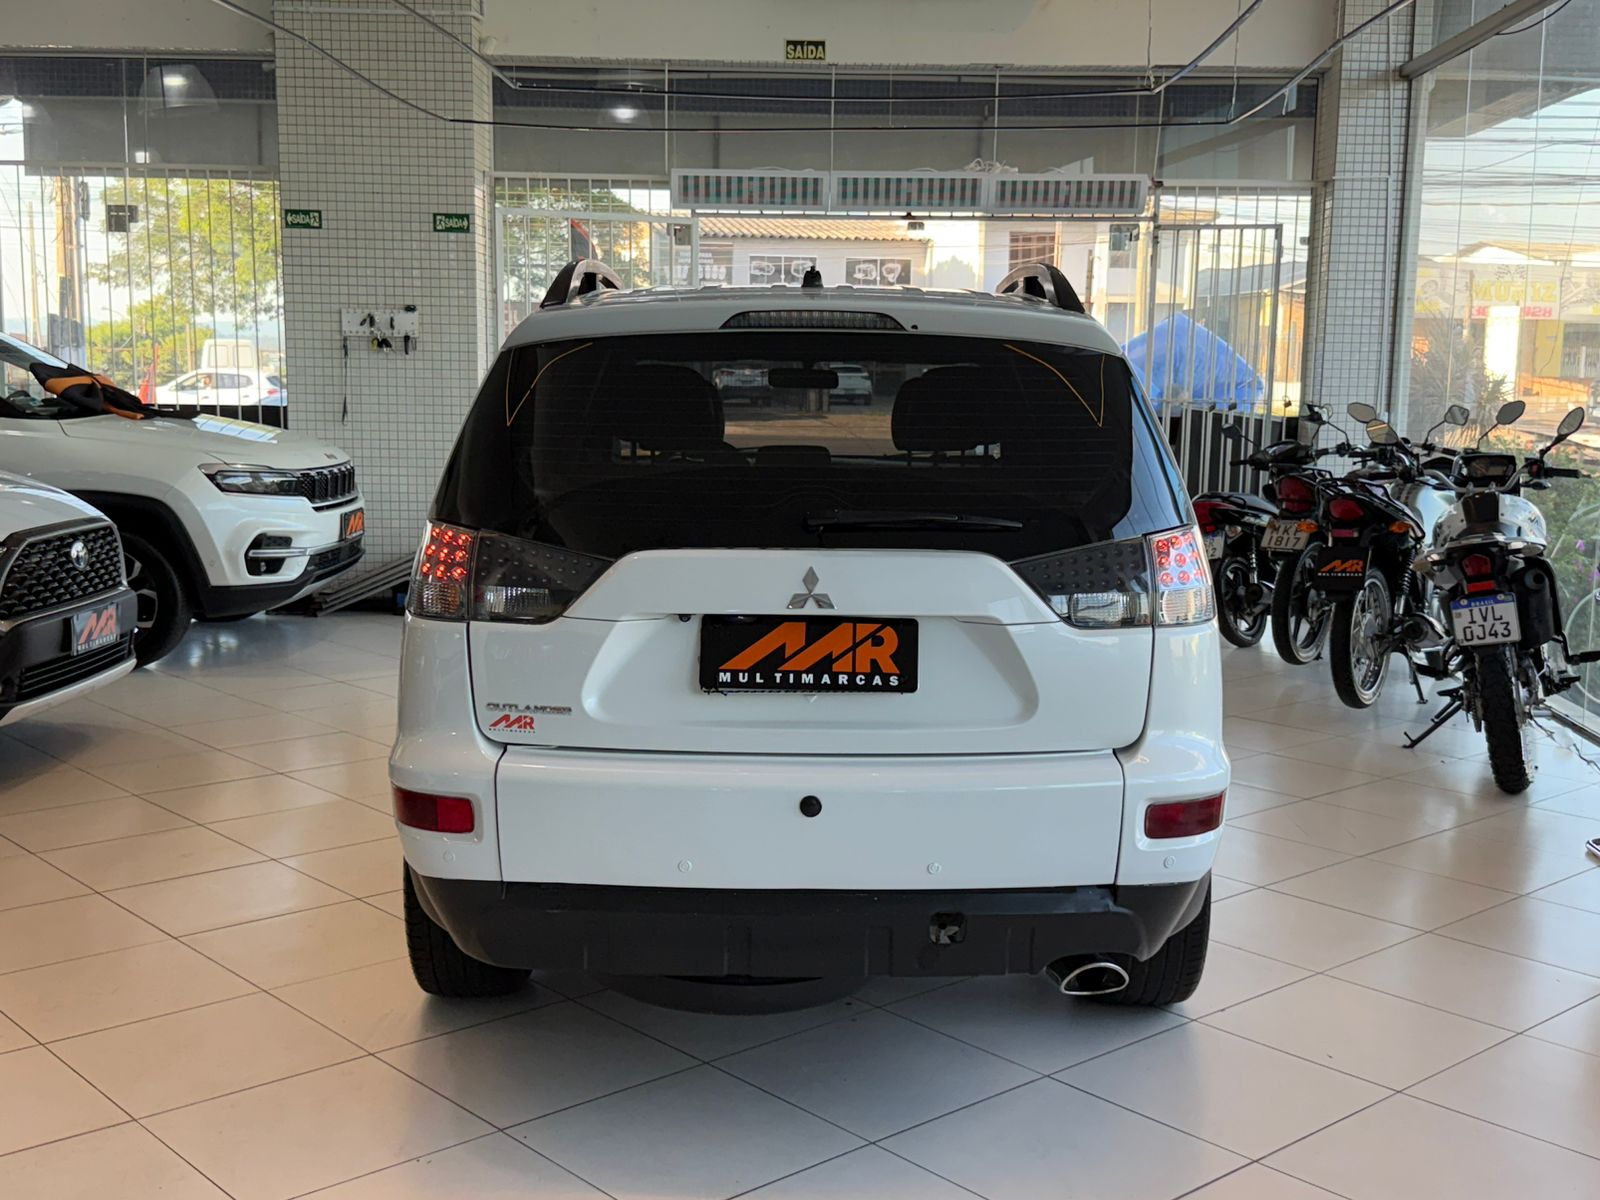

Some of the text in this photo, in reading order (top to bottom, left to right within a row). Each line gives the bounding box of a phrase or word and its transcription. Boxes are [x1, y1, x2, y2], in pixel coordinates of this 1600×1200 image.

[787, 41, 825, 59] SAÍDA
[1267, 536, 1302, 548] 1817
[1471, 599, 1495, 607] BRASIL
[1468, 606, 1503, 624] IVL
[719, 672, 899, 686] MULTIMARCAS
[486, 703, 572, 714] OUTLANDER
